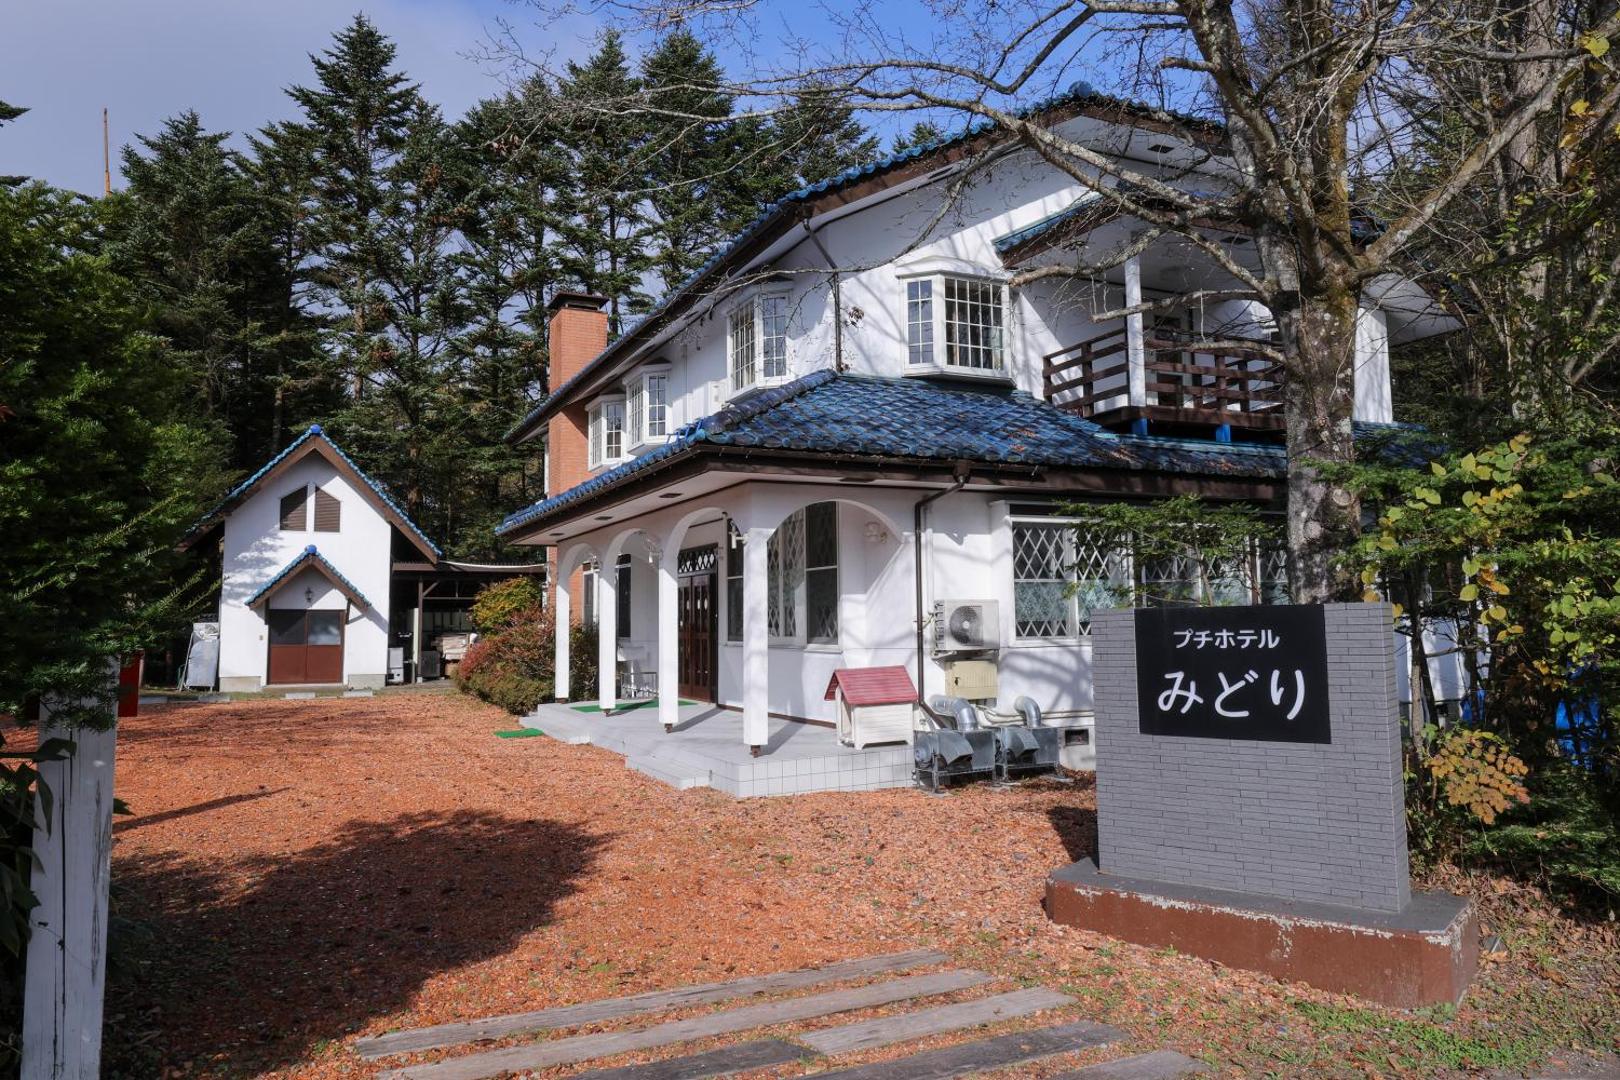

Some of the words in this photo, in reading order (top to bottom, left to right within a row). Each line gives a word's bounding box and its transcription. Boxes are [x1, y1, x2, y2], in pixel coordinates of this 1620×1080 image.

[1173, 629, 1280, 649] プチホテル
[1157, 669, 1306, 720] みどり
